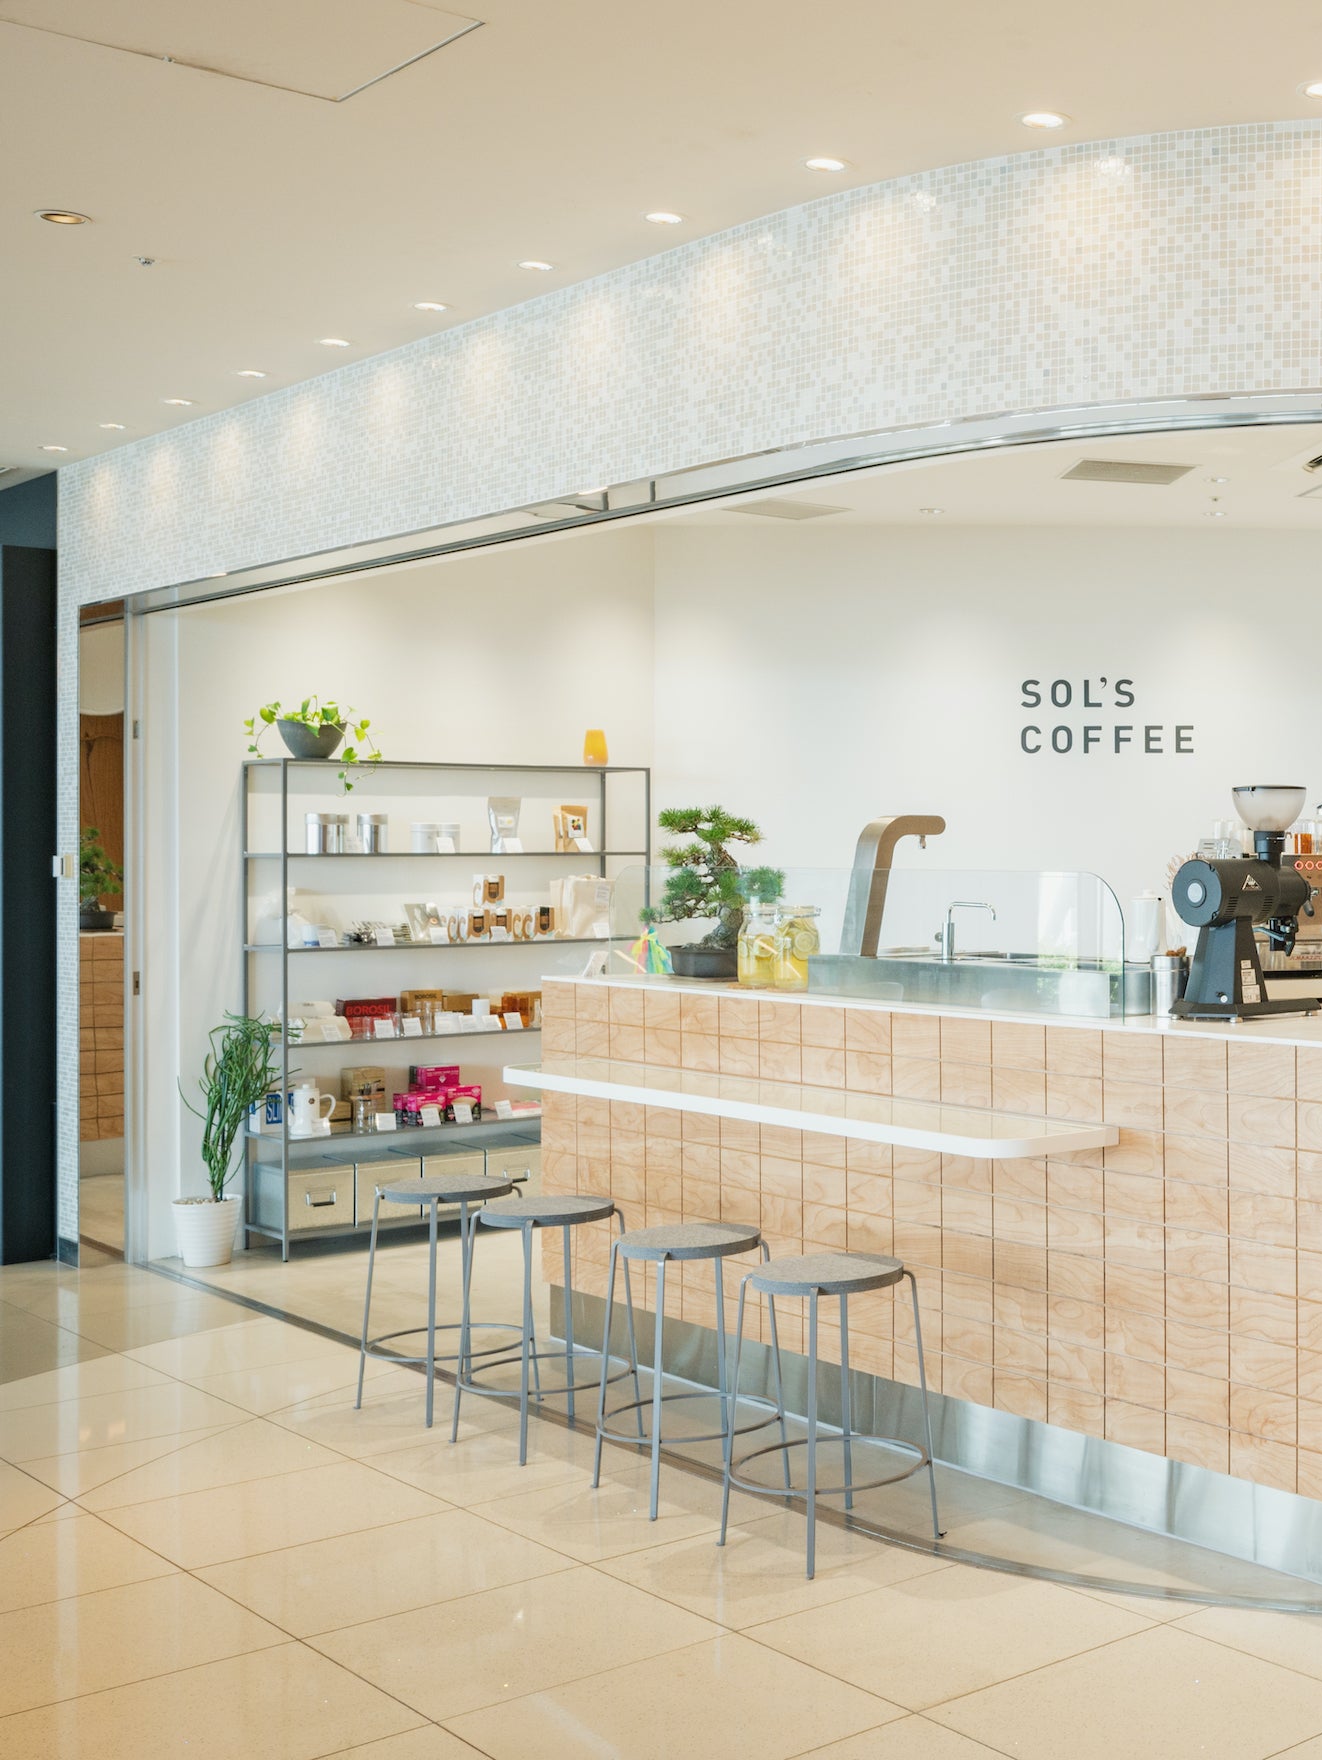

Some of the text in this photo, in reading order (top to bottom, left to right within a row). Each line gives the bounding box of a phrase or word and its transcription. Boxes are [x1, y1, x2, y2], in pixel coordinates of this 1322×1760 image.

[1020, 676, 1135, 708] SOL'S
[1020, 725, 1194, 754] COFFEE
[345, 1004, 391, 1016] BOROSIL
